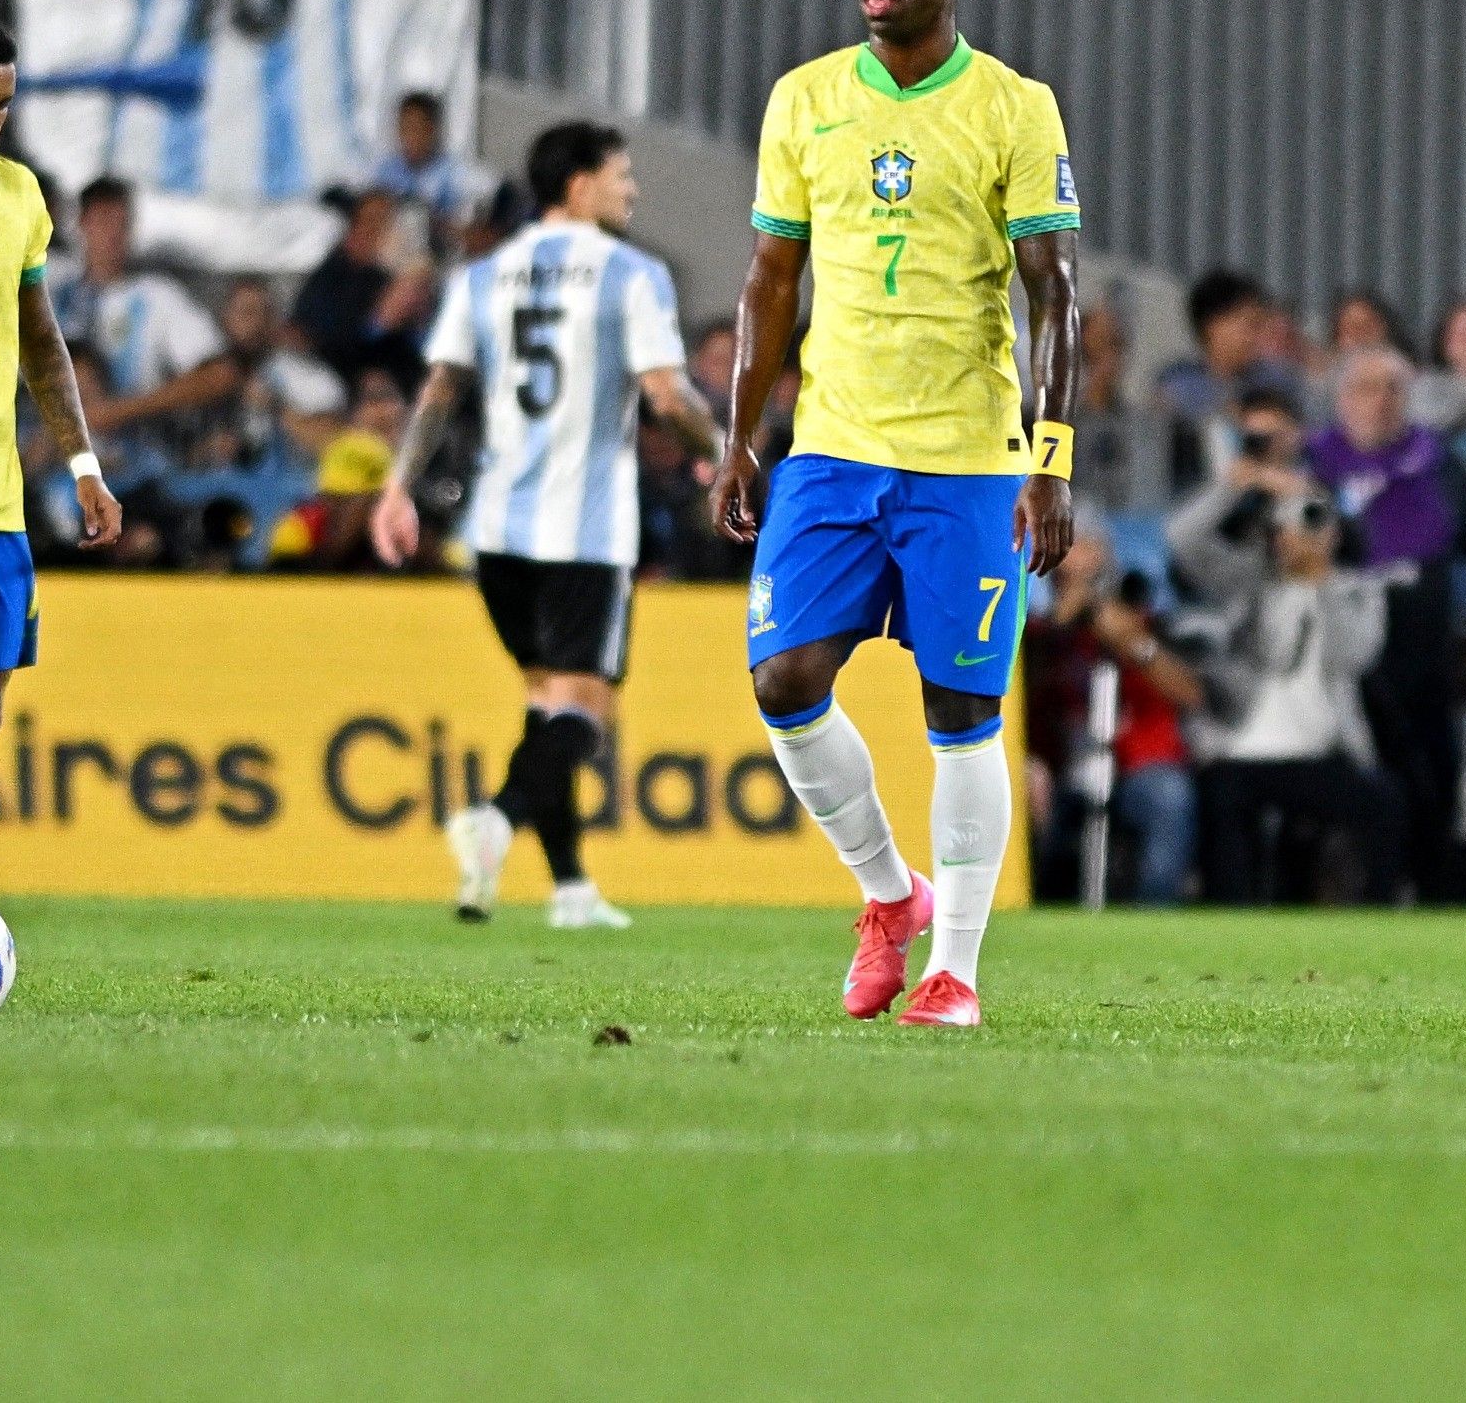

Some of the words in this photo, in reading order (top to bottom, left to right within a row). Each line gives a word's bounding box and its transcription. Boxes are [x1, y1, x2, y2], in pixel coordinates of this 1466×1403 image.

[872, 208, 914, 219] BRASIL
[877, 235, 907, 297] 7
[512, 306, 565, 421] 5
[1041, 436, 1060, 469] 7
[977, 576, 1007, 643] 7
